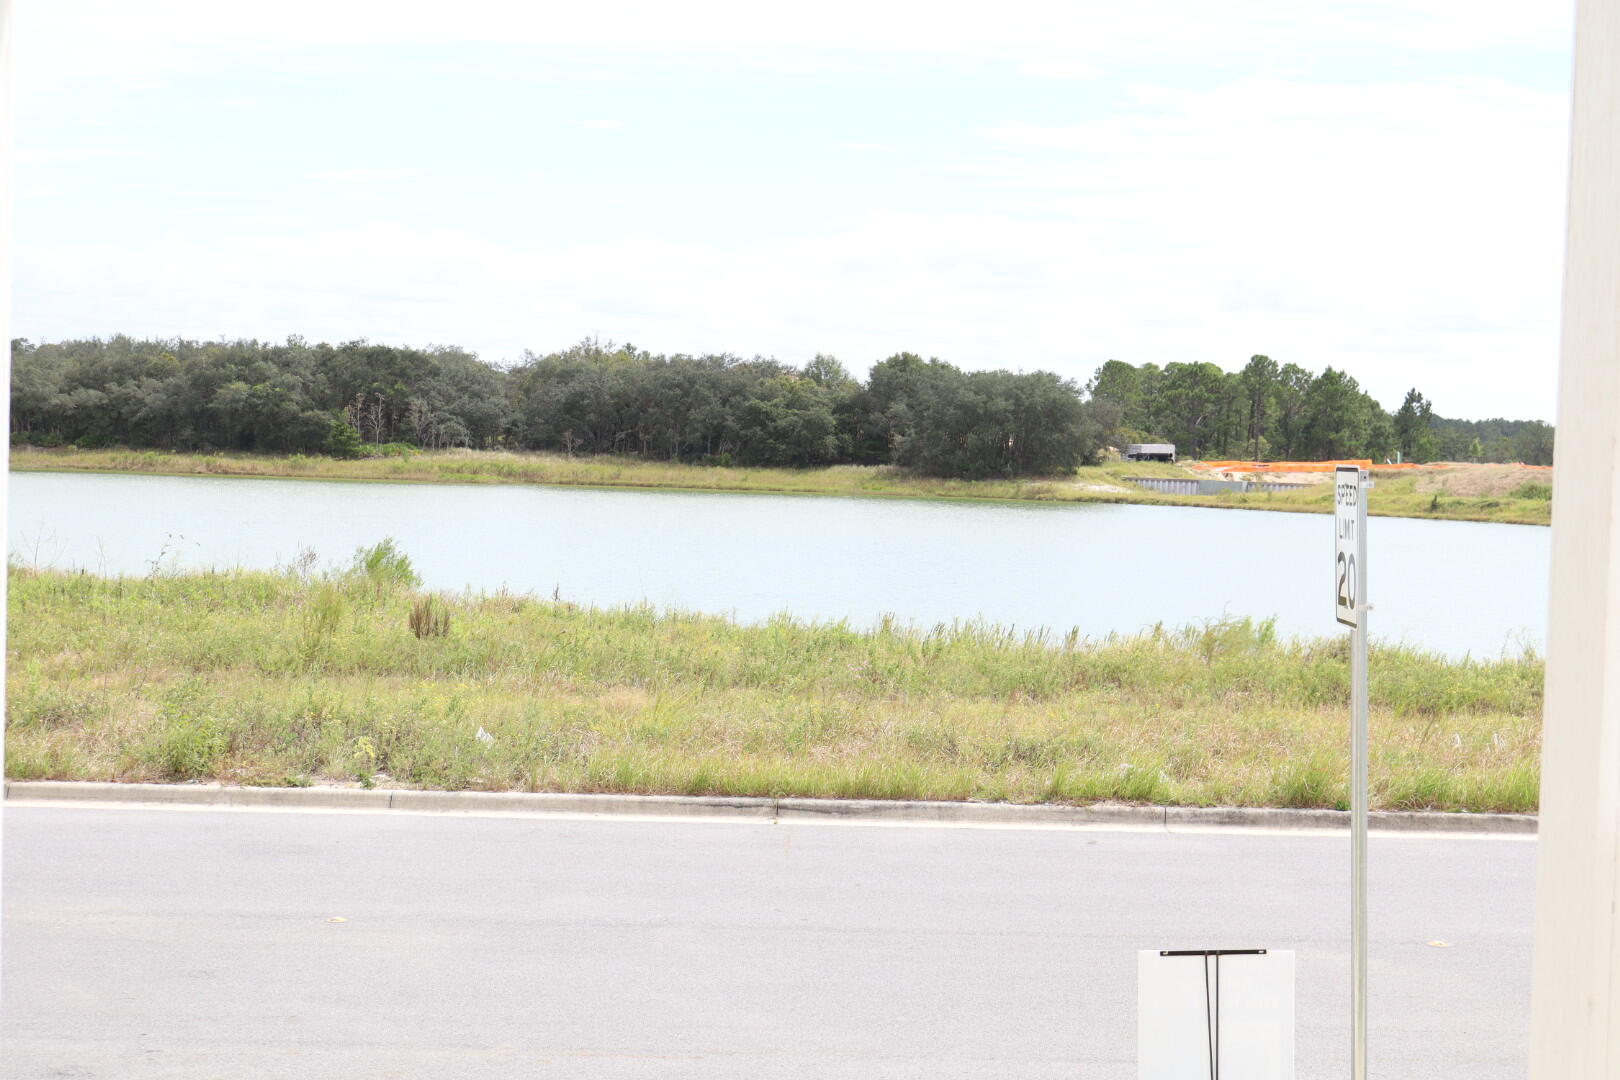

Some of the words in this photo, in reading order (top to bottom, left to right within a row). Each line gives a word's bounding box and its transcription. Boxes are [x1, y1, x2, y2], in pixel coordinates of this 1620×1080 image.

[1337, 483, 1357, 507] SPEED
[1338, 518, 1355, 541] LIMT
[1337, 551, 1356, 610] 20
